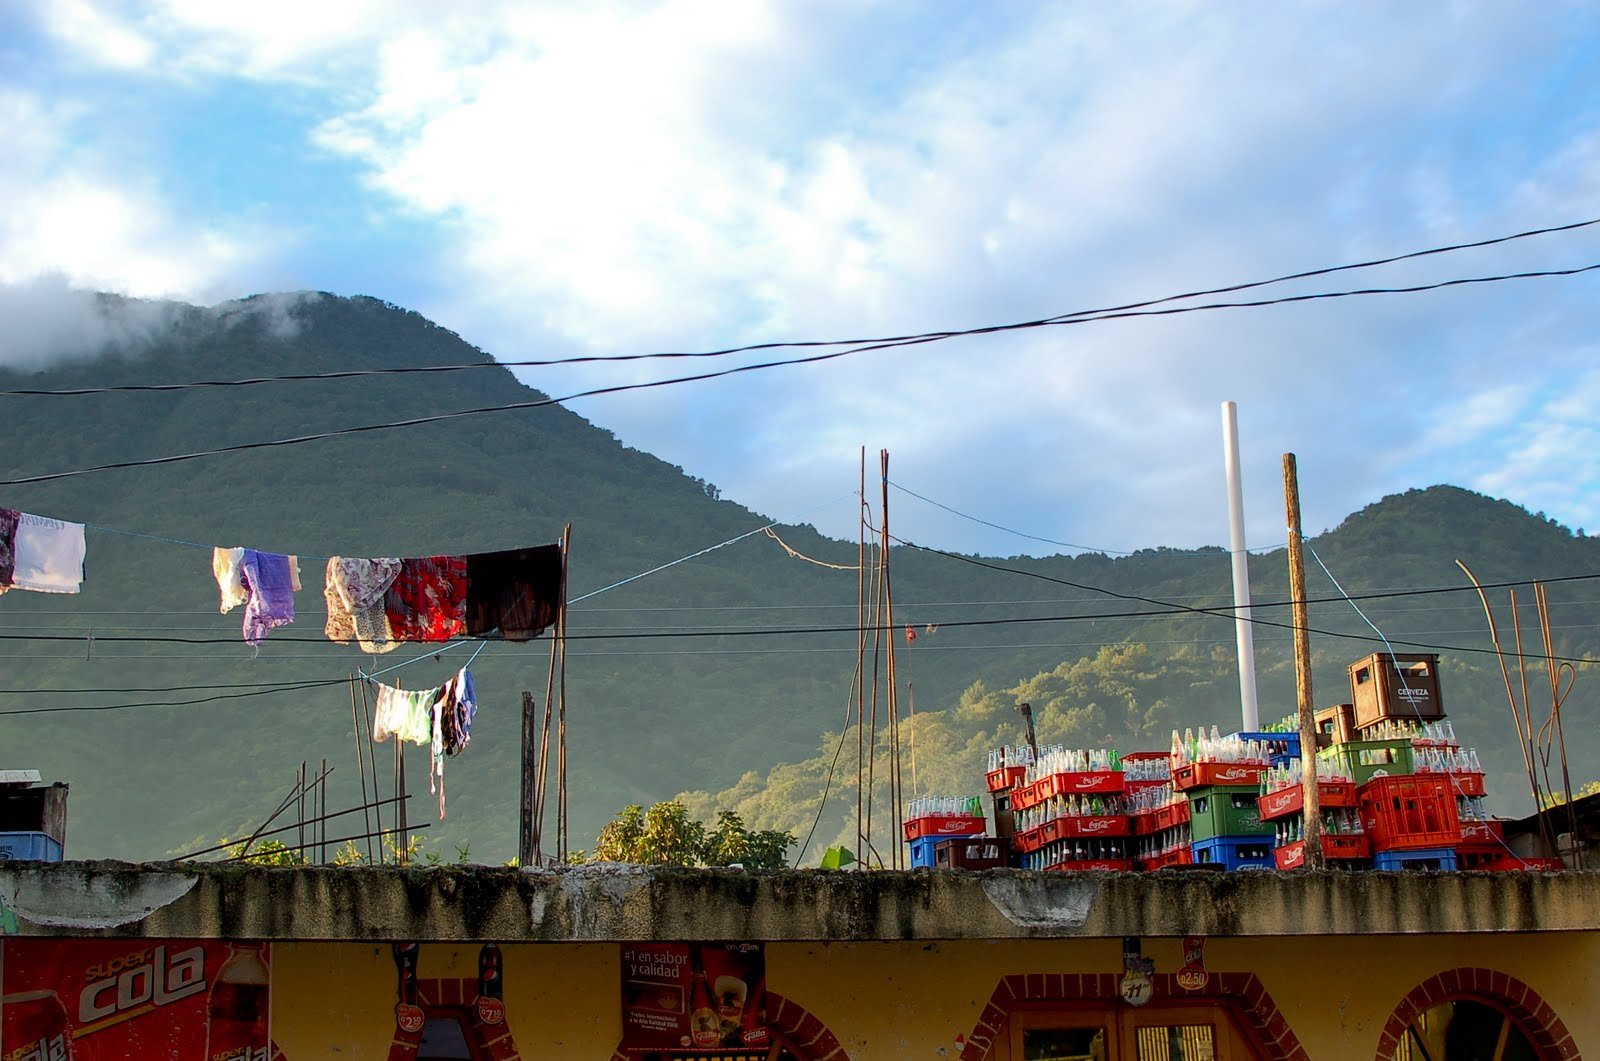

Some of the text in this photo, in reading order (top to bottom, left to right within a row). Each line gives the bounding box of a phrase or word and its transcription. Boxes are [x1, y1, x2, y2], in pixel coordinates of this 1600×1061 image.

[1397, 688, 1429, 696] CERVEZA
[624, 950, 688, 965] #1 en sabor
[631, 963, 680, 978] y calidad
[79, 945, 207, 1023] cola
